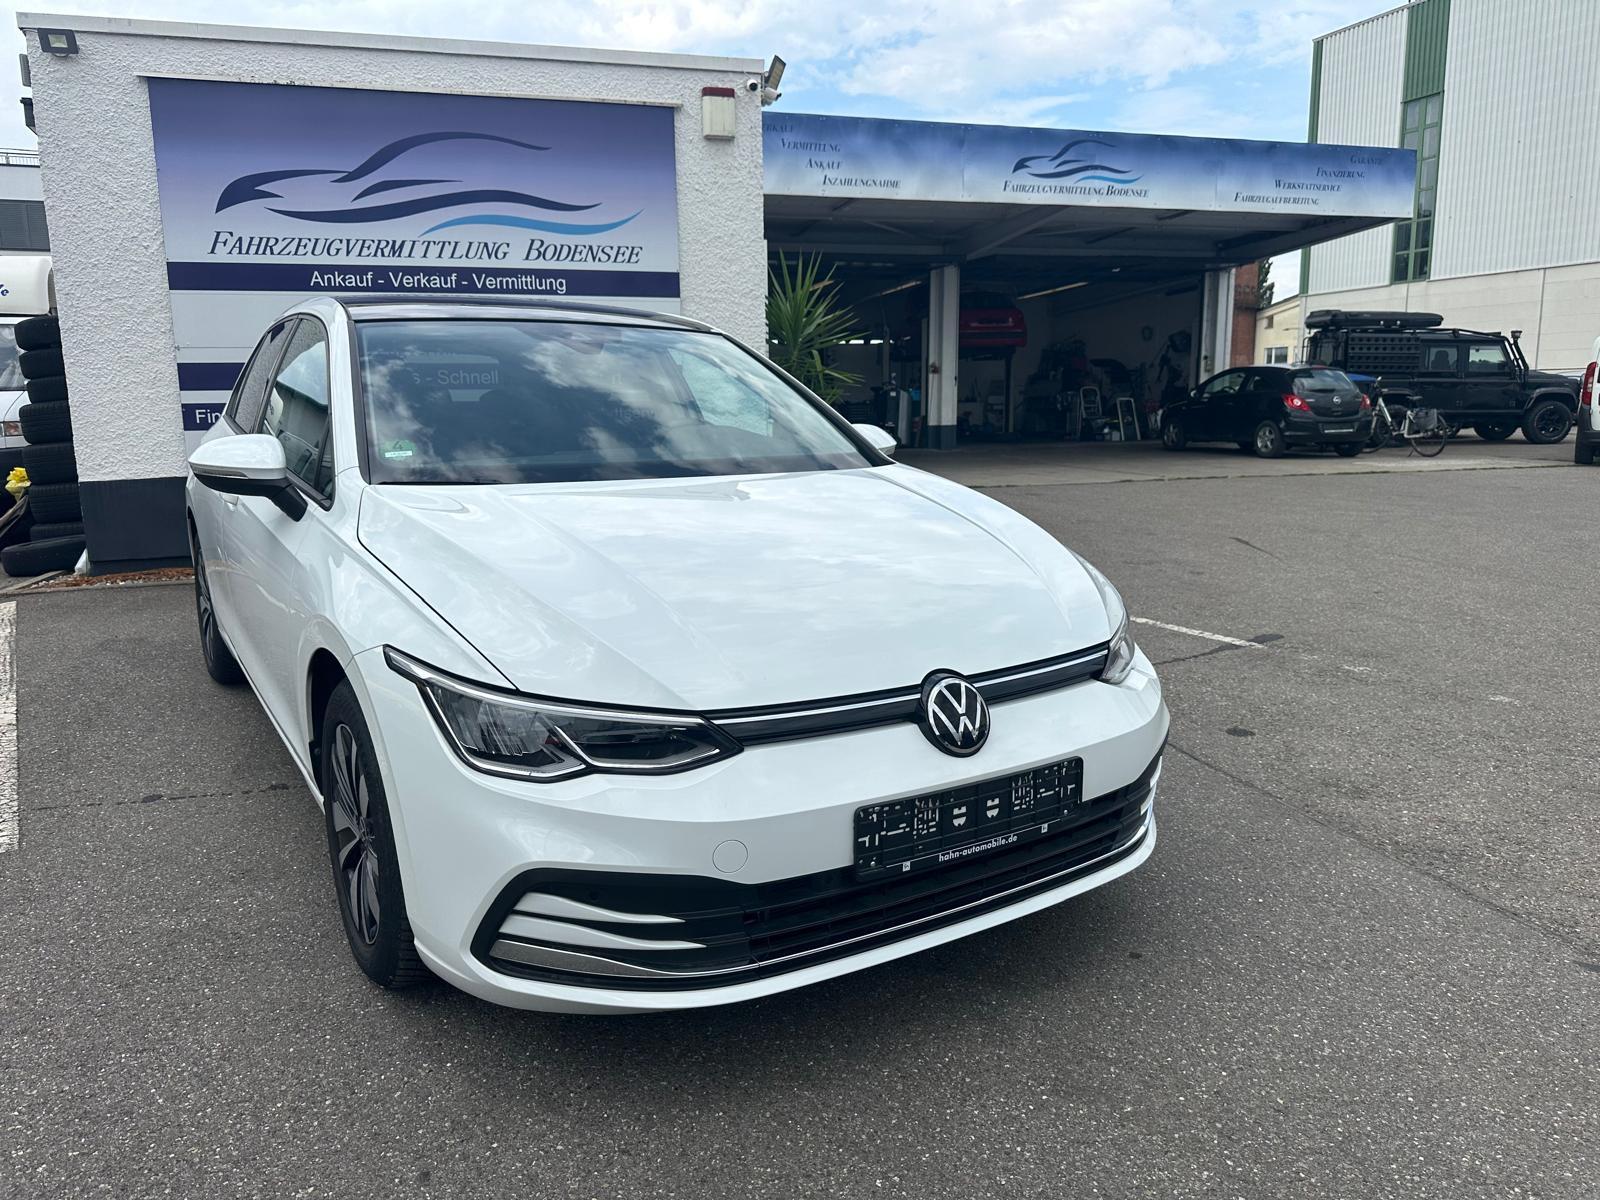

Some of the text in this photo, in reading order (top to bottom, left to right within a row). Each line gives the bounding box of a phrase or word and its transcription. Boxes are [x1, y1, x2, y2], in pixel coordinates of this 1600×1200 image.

[780, 138, 841, 153] VERMITTLUNG
[805, 157, 843, 171] ANKAUF
[1316, 167, 1366, 179] FINANZIERUNG
[822, 174, 900, 188] INZAHLUNGNAHME
[1274, 179, 1343, 192] WERKSTATTSERVICE
[1003, 180, 1150, 198] FAHRZEUGVERMITTLUNG BODENSEE
[1234, 192, 1320, 206] FAHRZEUGAUFBEREITUNG
[207, 230, 643, 264] FAHRZEUGVERMITTLUNG BODENSEE
[310, 270, 374, 288] Ankauf
[389, 271, 458, 289] Verkauf
[472, 273, 567, 294] Vermittlung
[437, 369, 499, 385] Schnell
[928, 679, 987, 747] VW
[938, 834, 1018, 862] hahn-automobile.de
